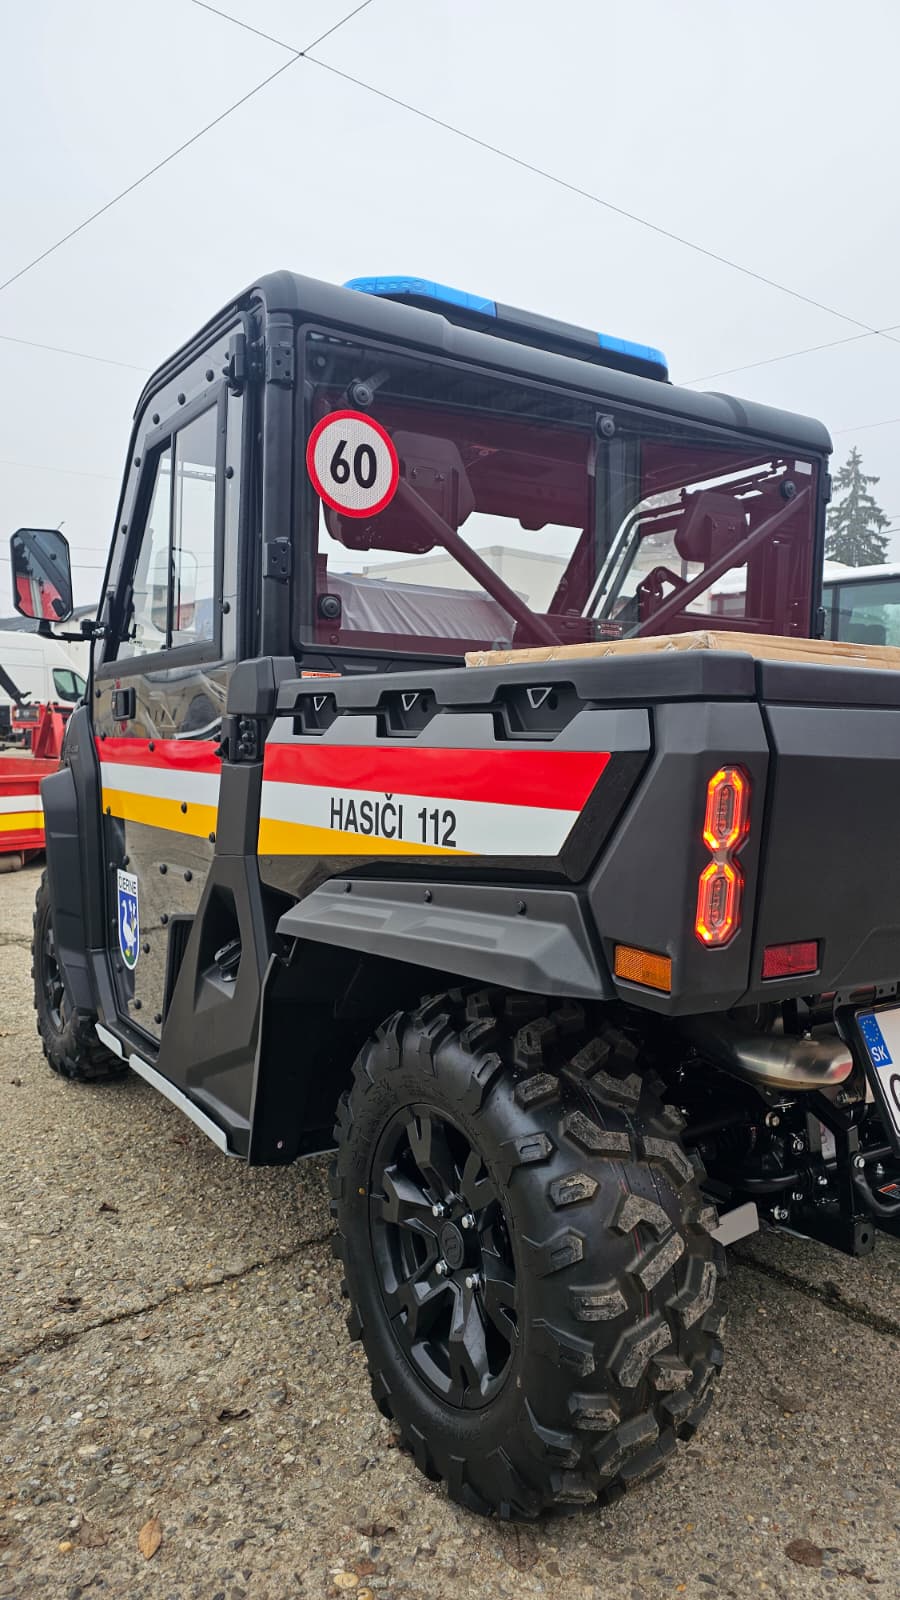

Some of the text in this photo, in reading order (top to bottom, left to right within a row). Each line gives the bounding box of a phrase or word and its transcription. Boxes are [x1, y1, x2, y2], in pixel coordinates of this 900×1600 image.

[330, 440, 377, 489] 60
[330, 793, 457, 848] HASIČI 112
[871, 1046, 889, 1062] SK
